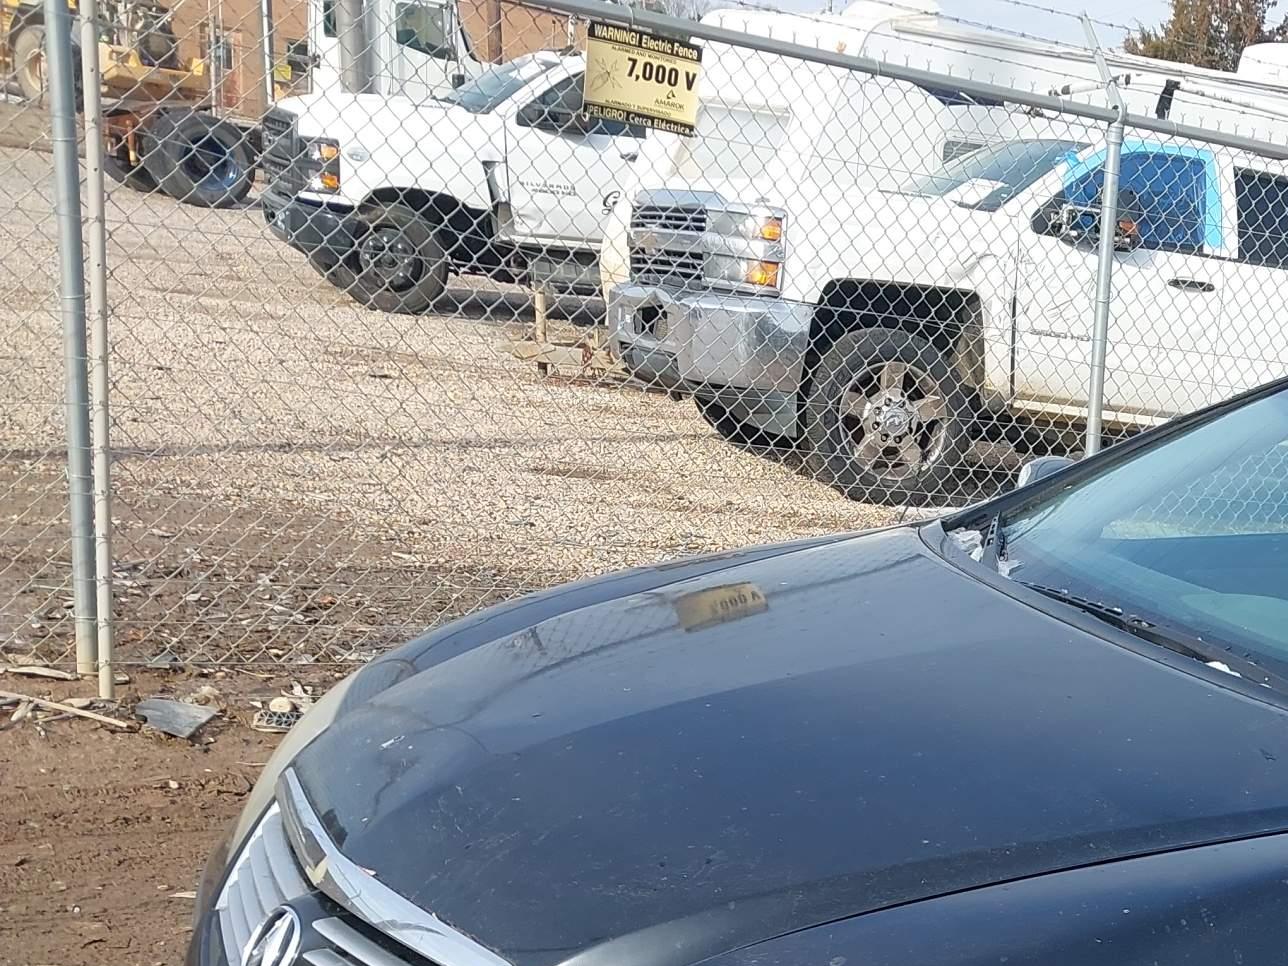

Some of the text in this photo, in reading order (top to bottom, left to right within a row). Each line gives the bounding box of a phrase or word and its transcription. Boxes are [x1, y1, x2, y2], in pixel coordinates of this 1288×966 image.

[594, 23, 698, 60] WARNING! Electric Fence
[626, 57, 697, 91] 7,000 V
[655, 98, 685, 110] AMAROK
[629, 113, 652, 127] Cerca
